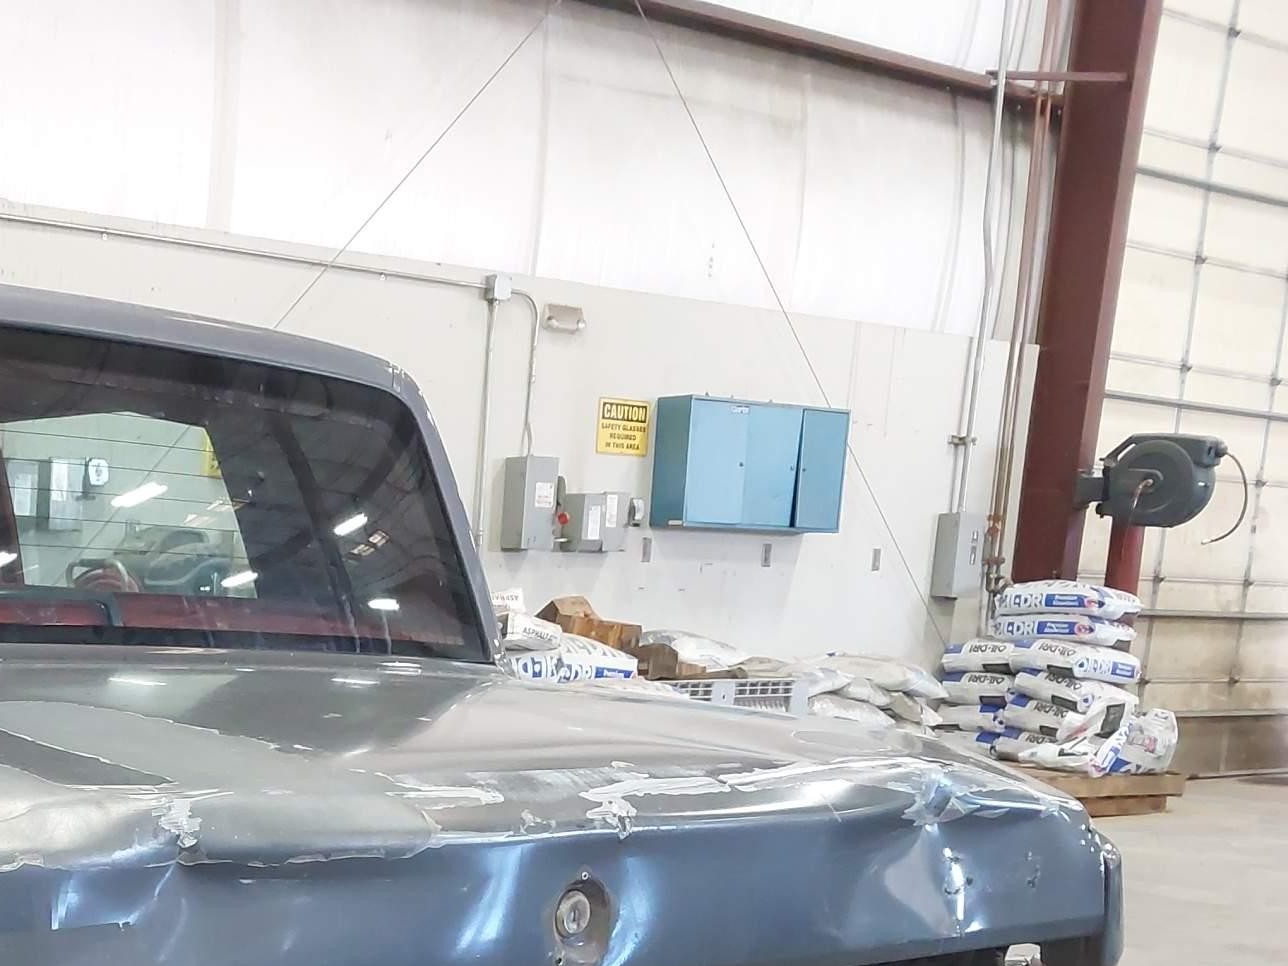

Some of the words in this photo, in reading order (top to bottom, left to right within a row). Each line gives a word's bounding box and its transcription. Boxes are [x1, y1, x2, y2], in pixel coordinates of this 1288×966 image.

[604, 403, 646, 422] CAUTION
[601, 422, 621, 431] SAFETY
[622, 424, 646, 433] GLASSES
[609, 432, 637, 441] REQUIRED
